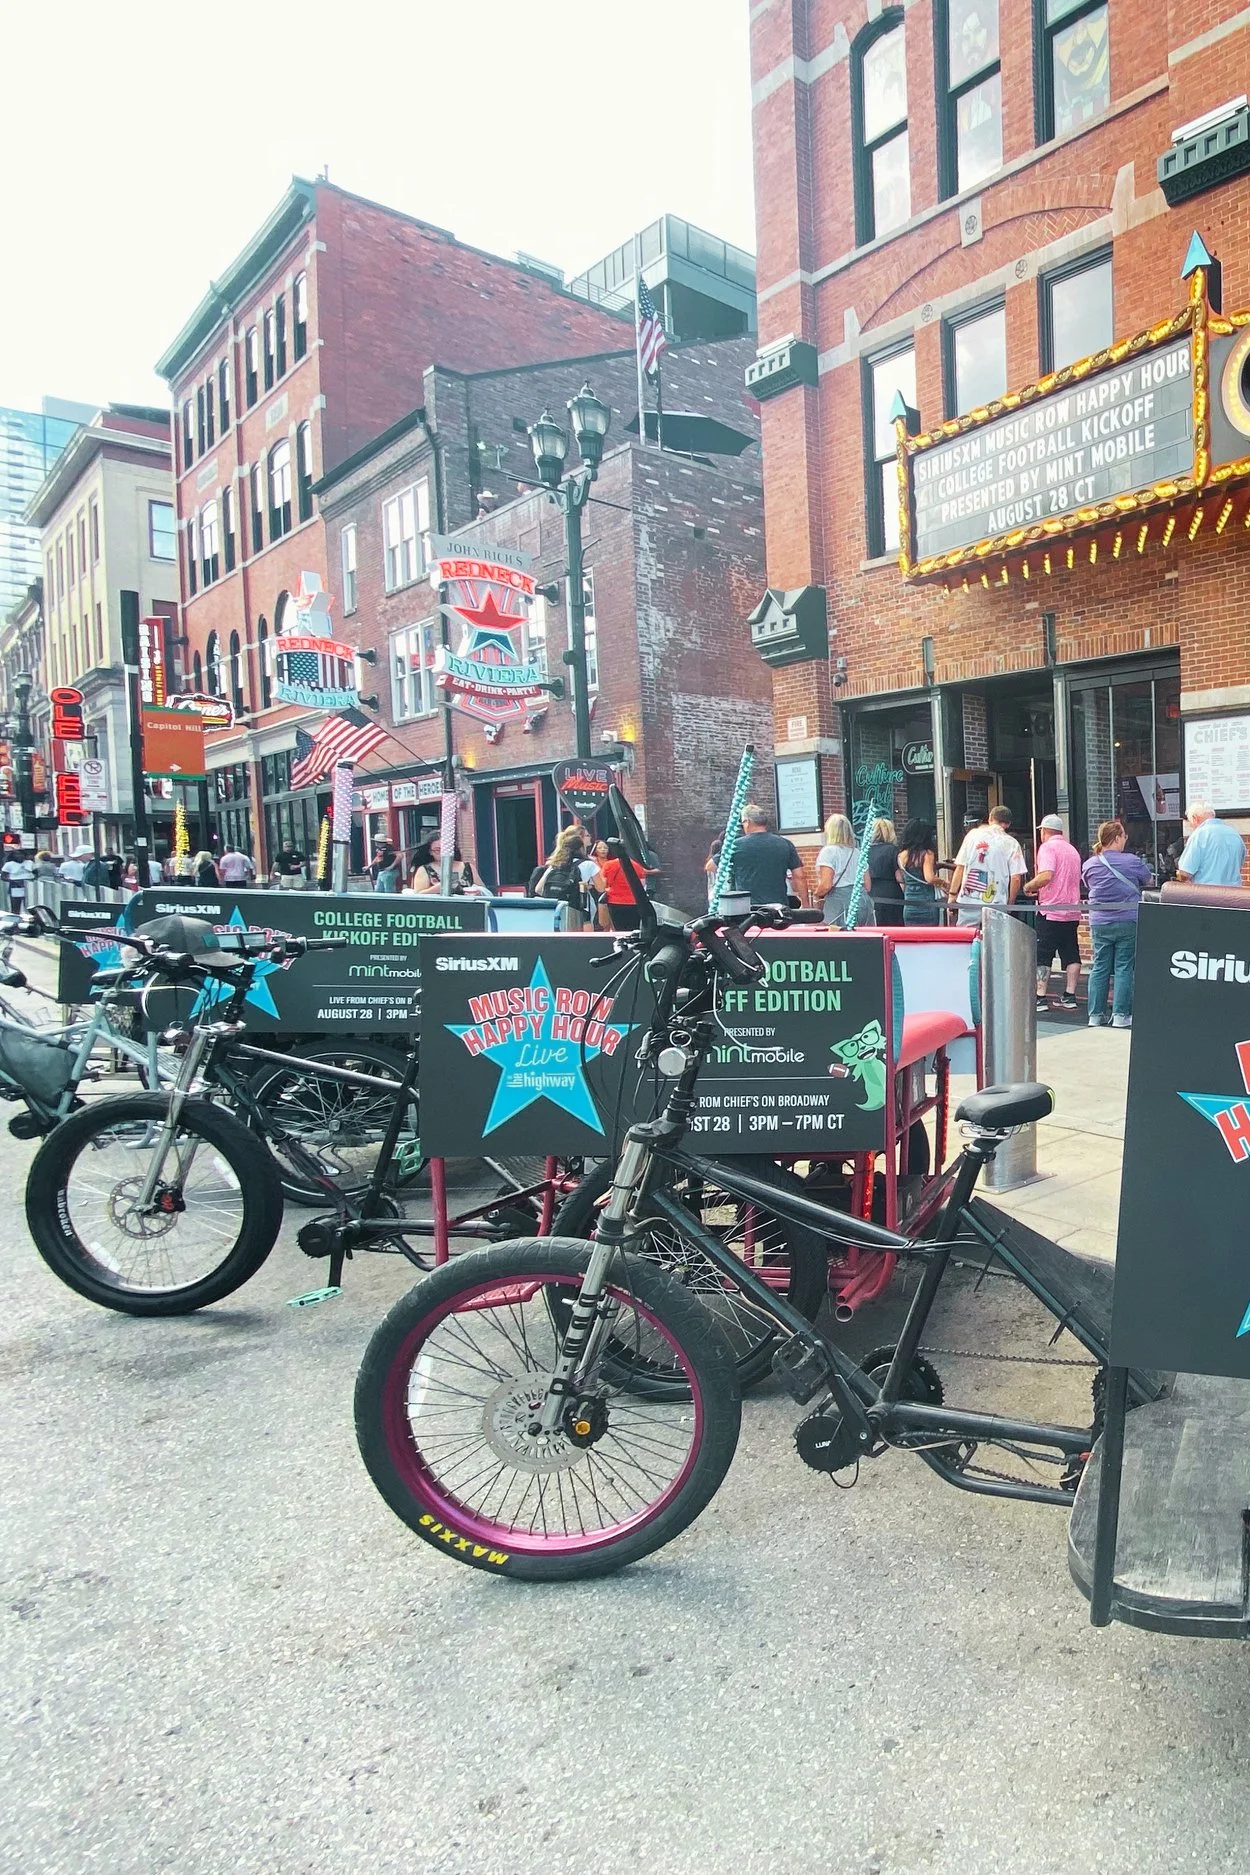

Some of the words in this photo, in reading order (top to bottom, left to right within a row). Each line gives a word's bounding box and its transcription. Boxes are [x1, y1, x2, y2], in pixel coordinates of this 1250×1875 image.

[919, 440, 981, 482] SIRIUSXM
[986, 419, 1029, 456] MUSIC
[1035, 403, 1070, 434] ROW
[1076, 377, 1133, 415] HAPPY
[1141, 348, 1190, 389] HOUR
[938, 461, 993, 498] COLLEGE
[1000, 437, 1075, 476] FOOTBALL
[1082, 394, 1154, 443] KICKOFF
[942, 480, 1014, 523] PRESENTED
[1020, 470, 1040, 493] BY
[1046, 451, 1085, 483] MINT
[1092, 425, 1154, 468] MOBILE
[988, 498, 1042, 533] AUGUST
[1049, 487, 1069, 512] 28
[1074, 476, 1096, 502] CT
[447, 542, 479, 558] JOHN
[439, 560, 536, 595] REDNECK
[276, 638, 355, 659] REDNECK
[450, 657, 541, 684] RIVIERA
[453, 678, 470, 689] EAT
[475, 684, 502, 695] DRINK
[280, 687, 357, 706] RIVIERA
[50, 687, 85, 739] OLE
[147, 722, 181, 731] Capitol
[185, 724, 202, 732] Hill
[1194, 726, 1248, 744] CHIEF'S
[565, 767, 607, 783] LIVE
[855, 762, 904, 787] Culture
[394, 787, 402, 800] OF
[403, 785, 415, 798] THE
[155, 903, 221, 915] SiriusXM
[314, 910, 382, 927] COLLEGE
[386, 914, 462, 930] FOOTBALL
[369, 954, 397, 962] PRESENTED
[435, 957, 519, 972] SiriusXM
[329, 996, 344, 1004] LIVE
[345, 996, 367, 1005] FROM
[368, 997, 394, 1005] CHIEF'S
[395, 997, 405, 1005] ON
[468, 987, 550, 1023] MUSIC
[555, 987, 616, 1023] ROW
[754, 989, 841, 1012] EDITION
[317, 1008, 358, 1020] AUGUST
[360, 1009, 373, 1020] 28
[386, 1009, 408, 1020] 3PM
[462, 1014, 545, 1057] HAPPY
[551, 1016, 623, 1056] HOUR
[724, 1028, 765, 1037] PRESENTED
[765, 1027, 776, 1037] BY
[515, 1043, 569, 1067] Live
[524, 1072, 575, 1091] highway
[699, 1096, 721, 1108] ROM
[723, 1095, 760, 1108] CHIEF'S
[761, 1095, 775, 1107] ON
[778, 1094, 830, 1107] BROADWAY
[714, 1116, 730, 1131] 28
[749, 1115, 778, 1131] 3PM
[795, 1115, 823, 1130] 7PM
[827, 1114, 845, 1130] CT
[419, 1514, 510, 1565] MAXXIS
